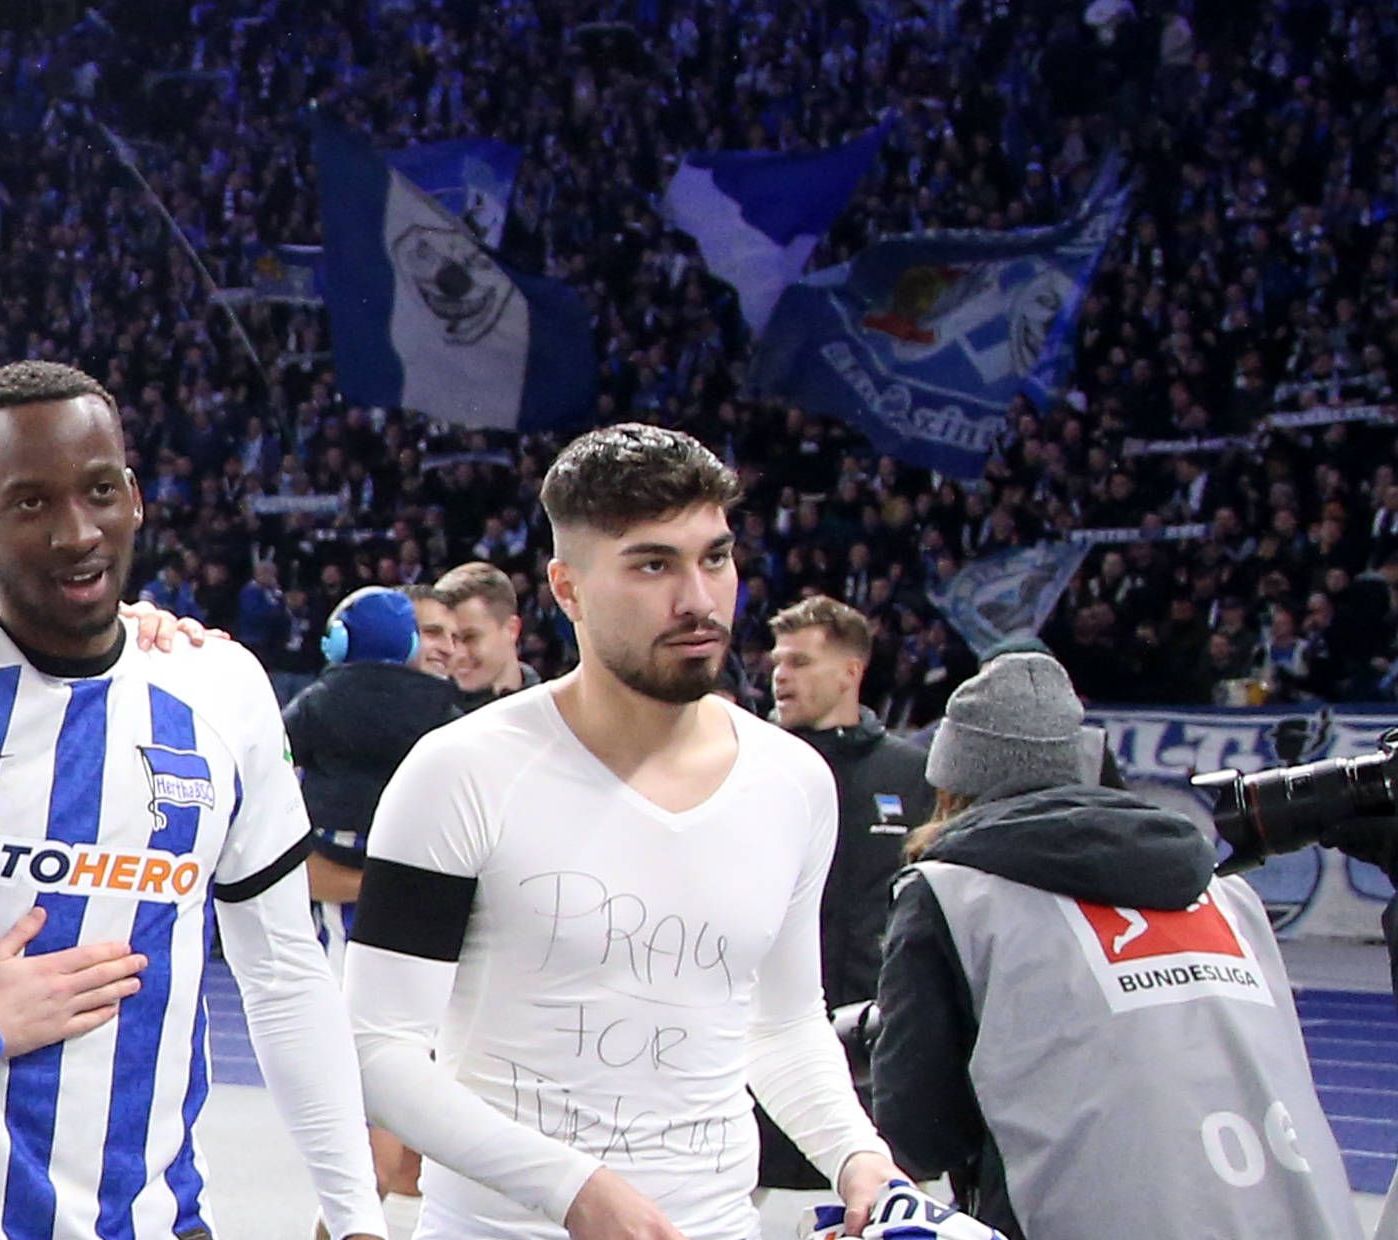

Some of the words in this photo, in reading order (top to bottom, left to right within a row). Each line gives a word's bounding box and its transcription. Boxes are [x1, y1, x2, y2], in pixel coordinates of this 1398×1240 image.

[519, 870, 733, 1001] PRAY
[1117, 964, 1259, 993] BUNDESLIGA
[532, 1002, 693, 1073] FOR
